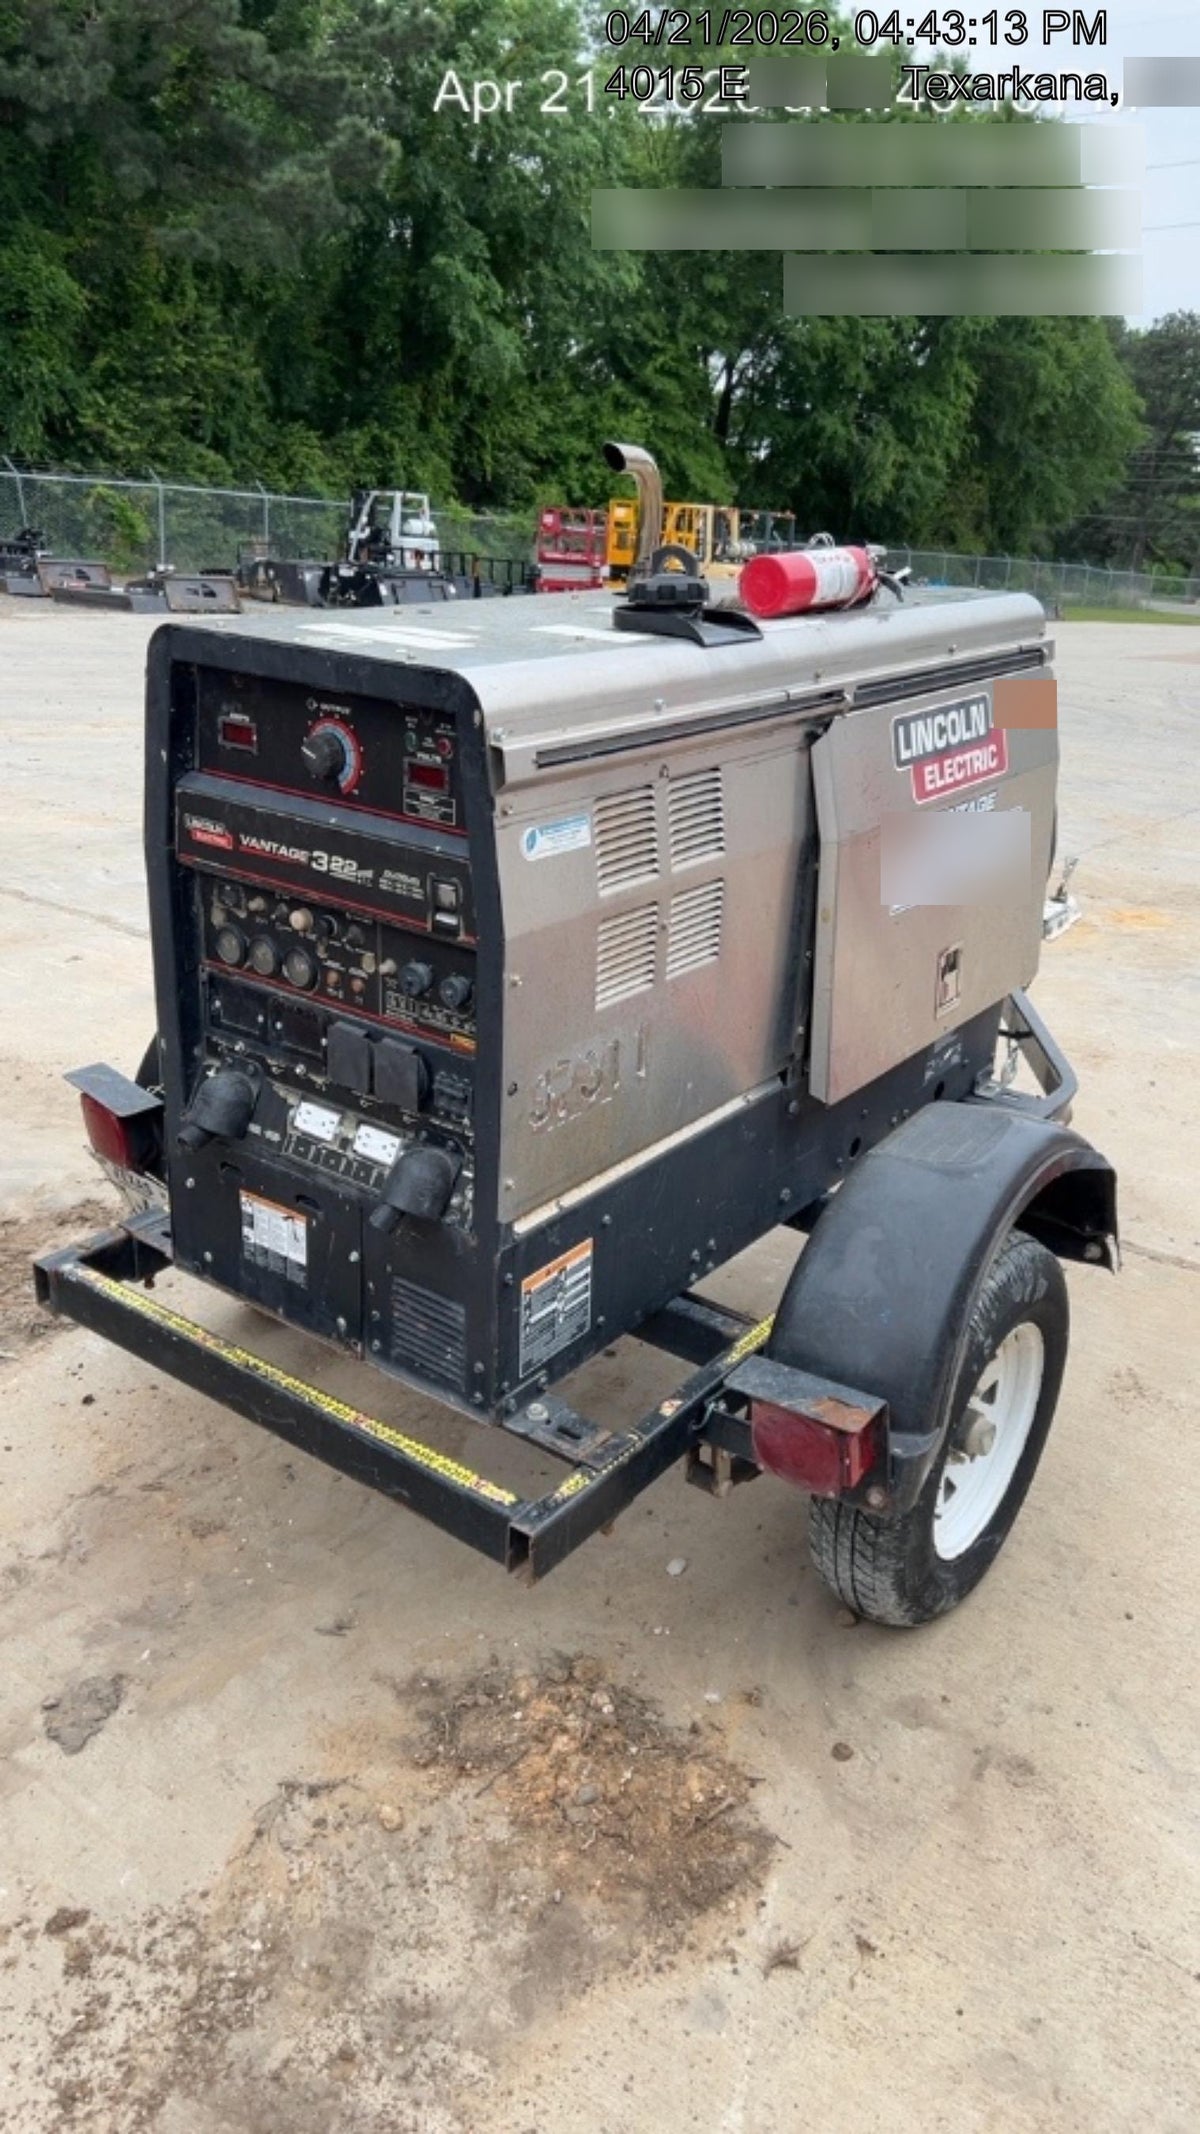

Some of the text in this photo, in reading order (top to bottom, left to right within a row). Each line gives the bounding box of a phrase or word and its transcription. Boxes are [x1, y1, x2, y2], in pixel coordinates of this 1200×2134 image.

[898, 703, 987, 761] LINCOLN
[923, 744, 998, 791] ELECTRIC
[239, 833, 309, 865] VANTAGE
[311, 851, 358, 873] 322
